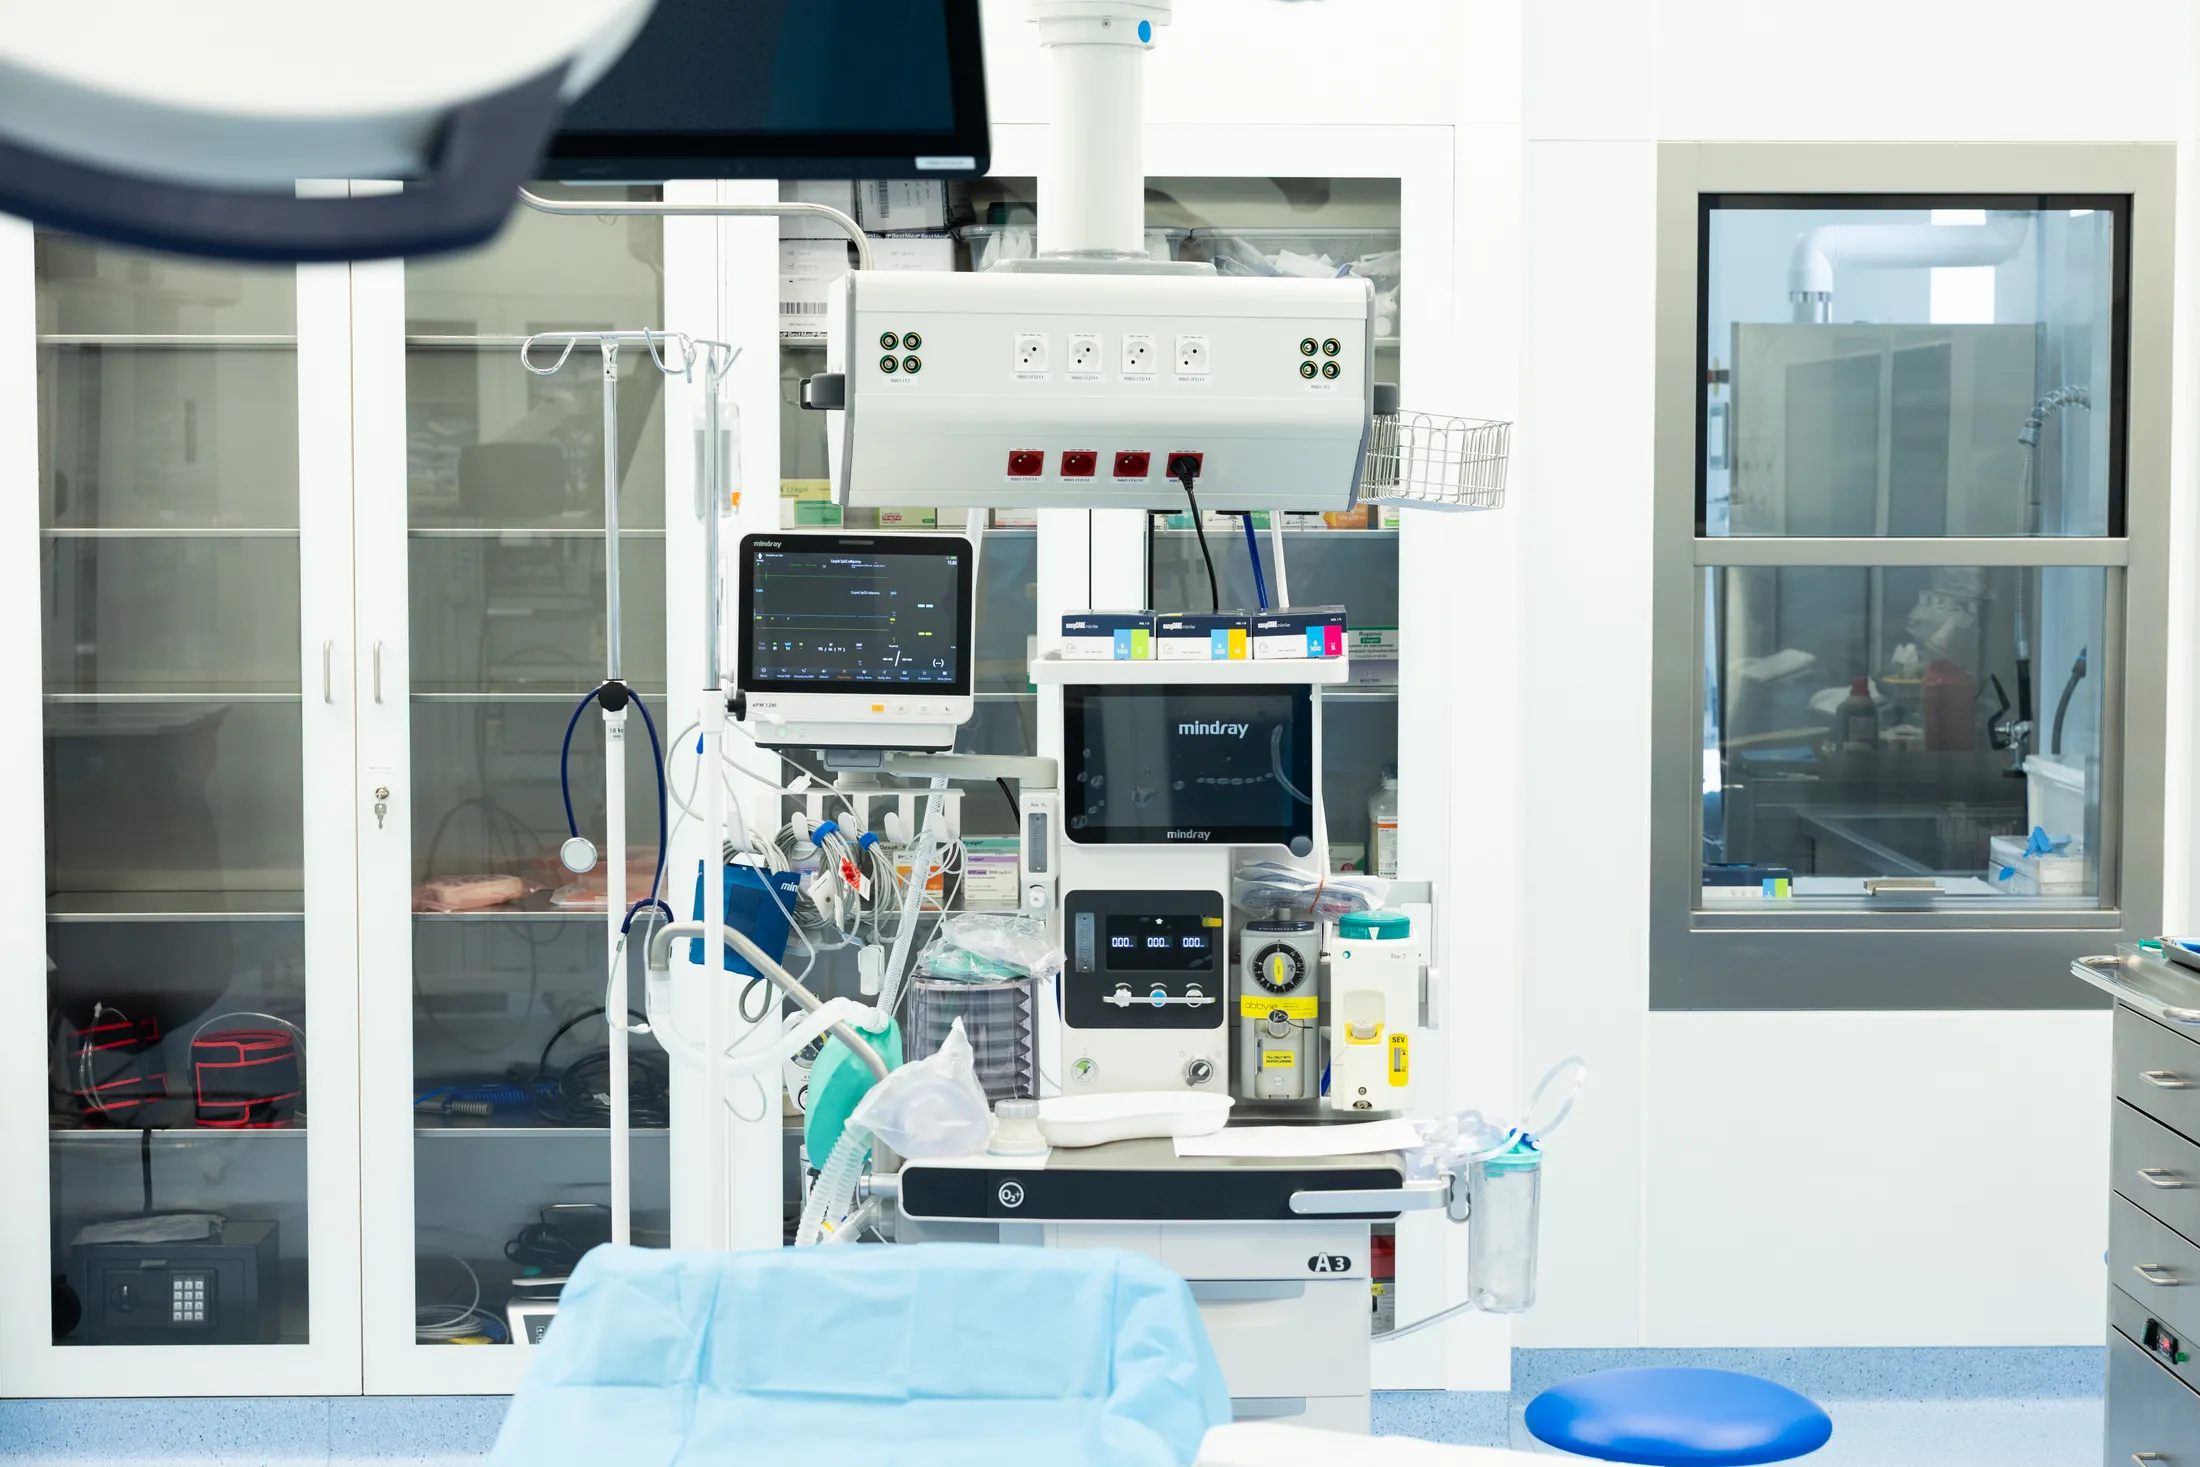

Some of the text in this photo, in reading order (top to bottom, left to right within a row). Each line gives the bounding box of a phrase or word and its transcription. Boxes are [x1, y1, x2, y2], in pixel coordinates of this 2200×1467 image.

[753, 540, 782, 549] mindray
[1178, 720, 1249, 739] mindray
[1167, 829, 1211, 841] mindray
[1244, 1000, 1278, 1010] abbvie
[1314, 1251, 1345, 1272] A3
